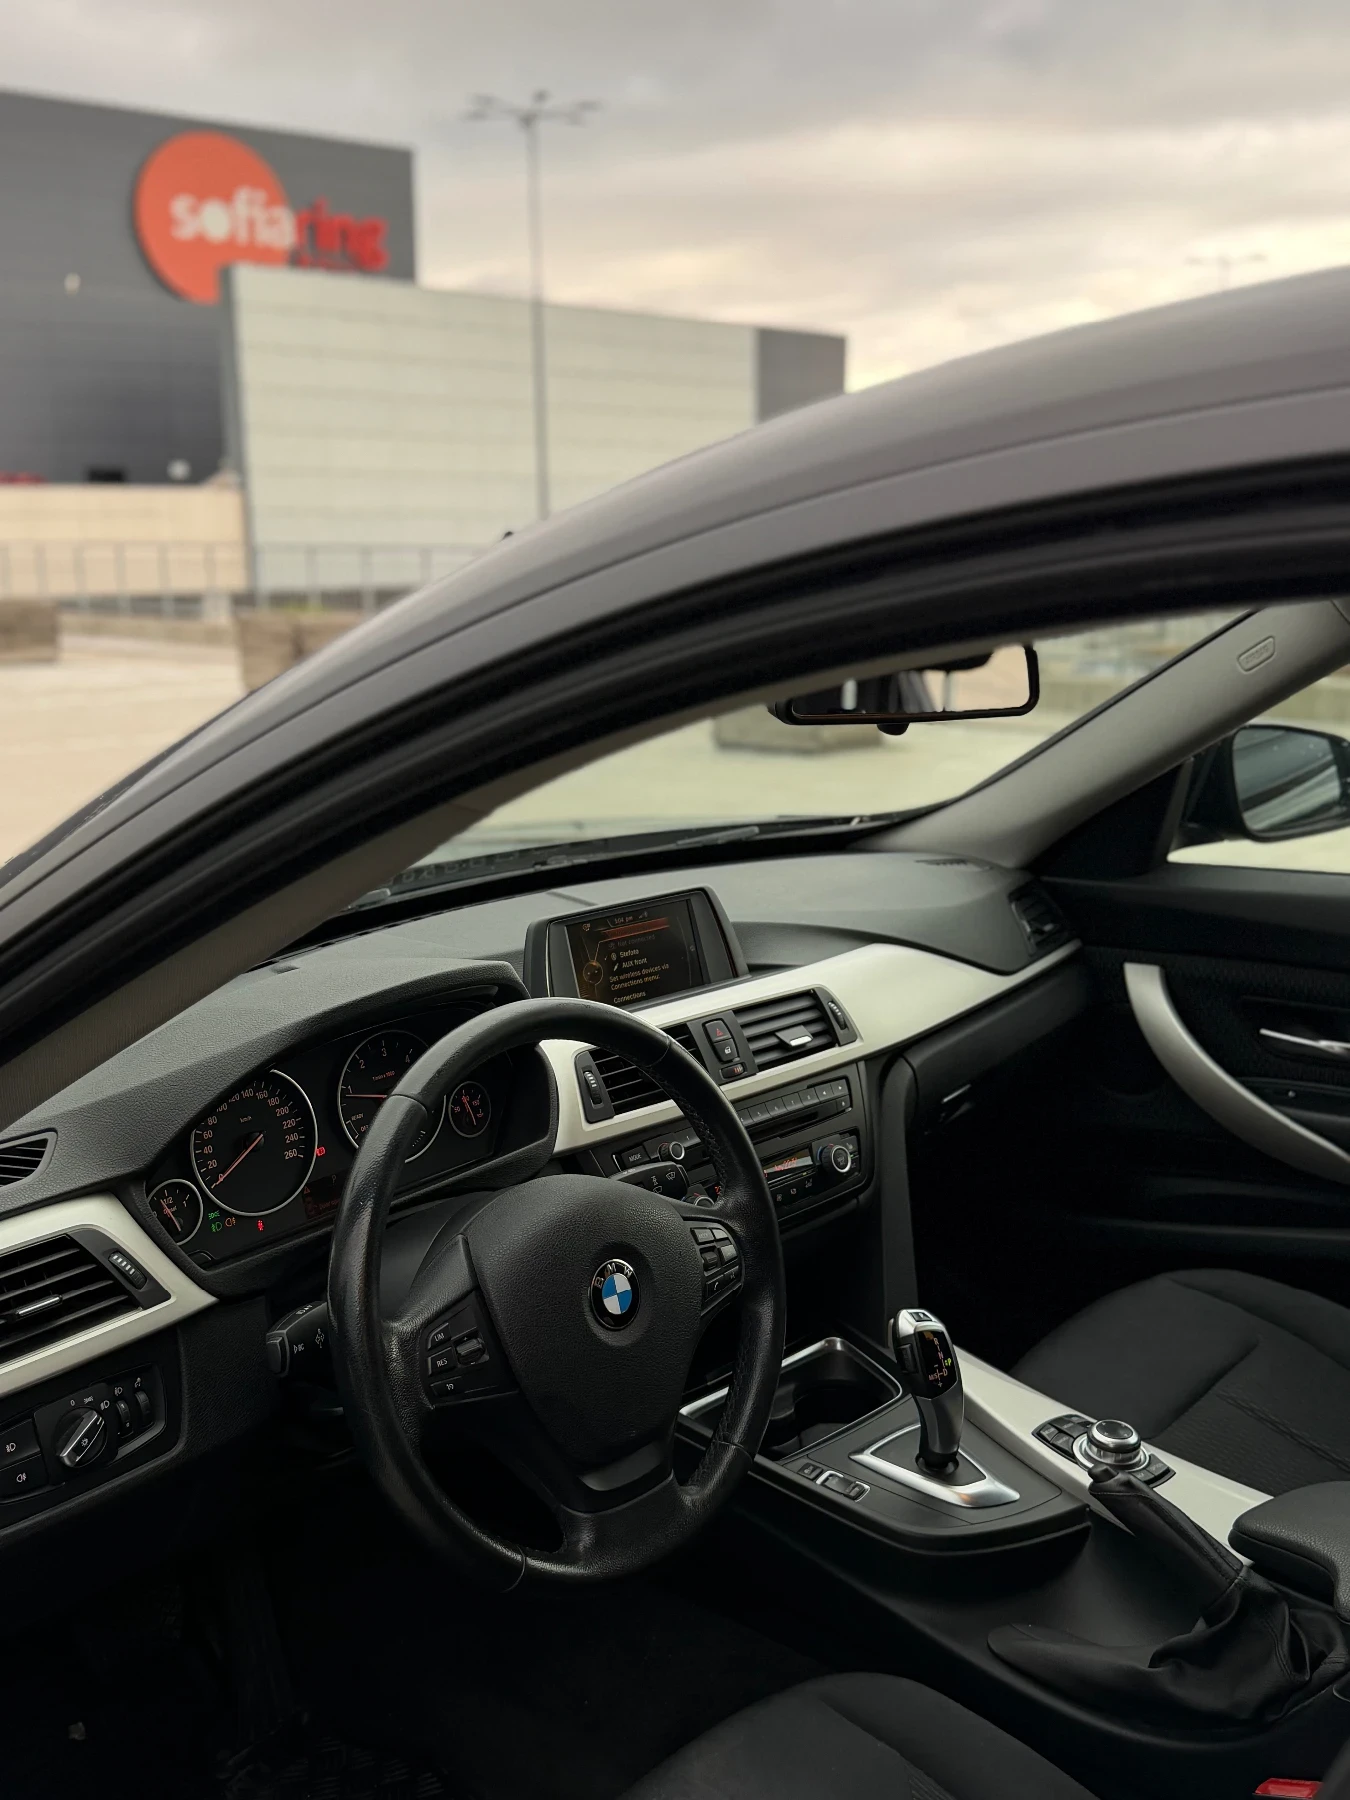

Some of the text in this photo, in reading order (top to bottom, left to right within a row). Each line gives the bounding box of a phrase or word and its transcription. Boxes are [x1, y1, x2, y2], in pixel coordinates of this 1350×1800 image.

[622, 960, 634, 968] AUX
[620, 971, 641, 980] wireless
[642, 966, 661, 975] devices
[611, 979, 643, 990] Connections
[614, 991, 645, 1003] Connections
[359, 1060, 366, 1069] 2
[240, 1088, 254, 1099] 140
[256, 1090, 268, 1100] 160
[268, 1096, 280, 1107] 180
[276, 1106, 289, 1117] 200
[208, 1115, 218, 1126] 80
[282, 1118, 296, 1130] 220
[203, 1130, 213, 1140] 60
[285, 1132, 299, 1144] 240
[203, 1145, 213, 1155] 40
[284, 1148, 298, 1160] 260
[207, 1159, 218, 1169] 20
[594, 1262, 634, 1289] BMW
[434, 1331, 445, 1342] LIM
[436, 1357, 448, 1368] RES
